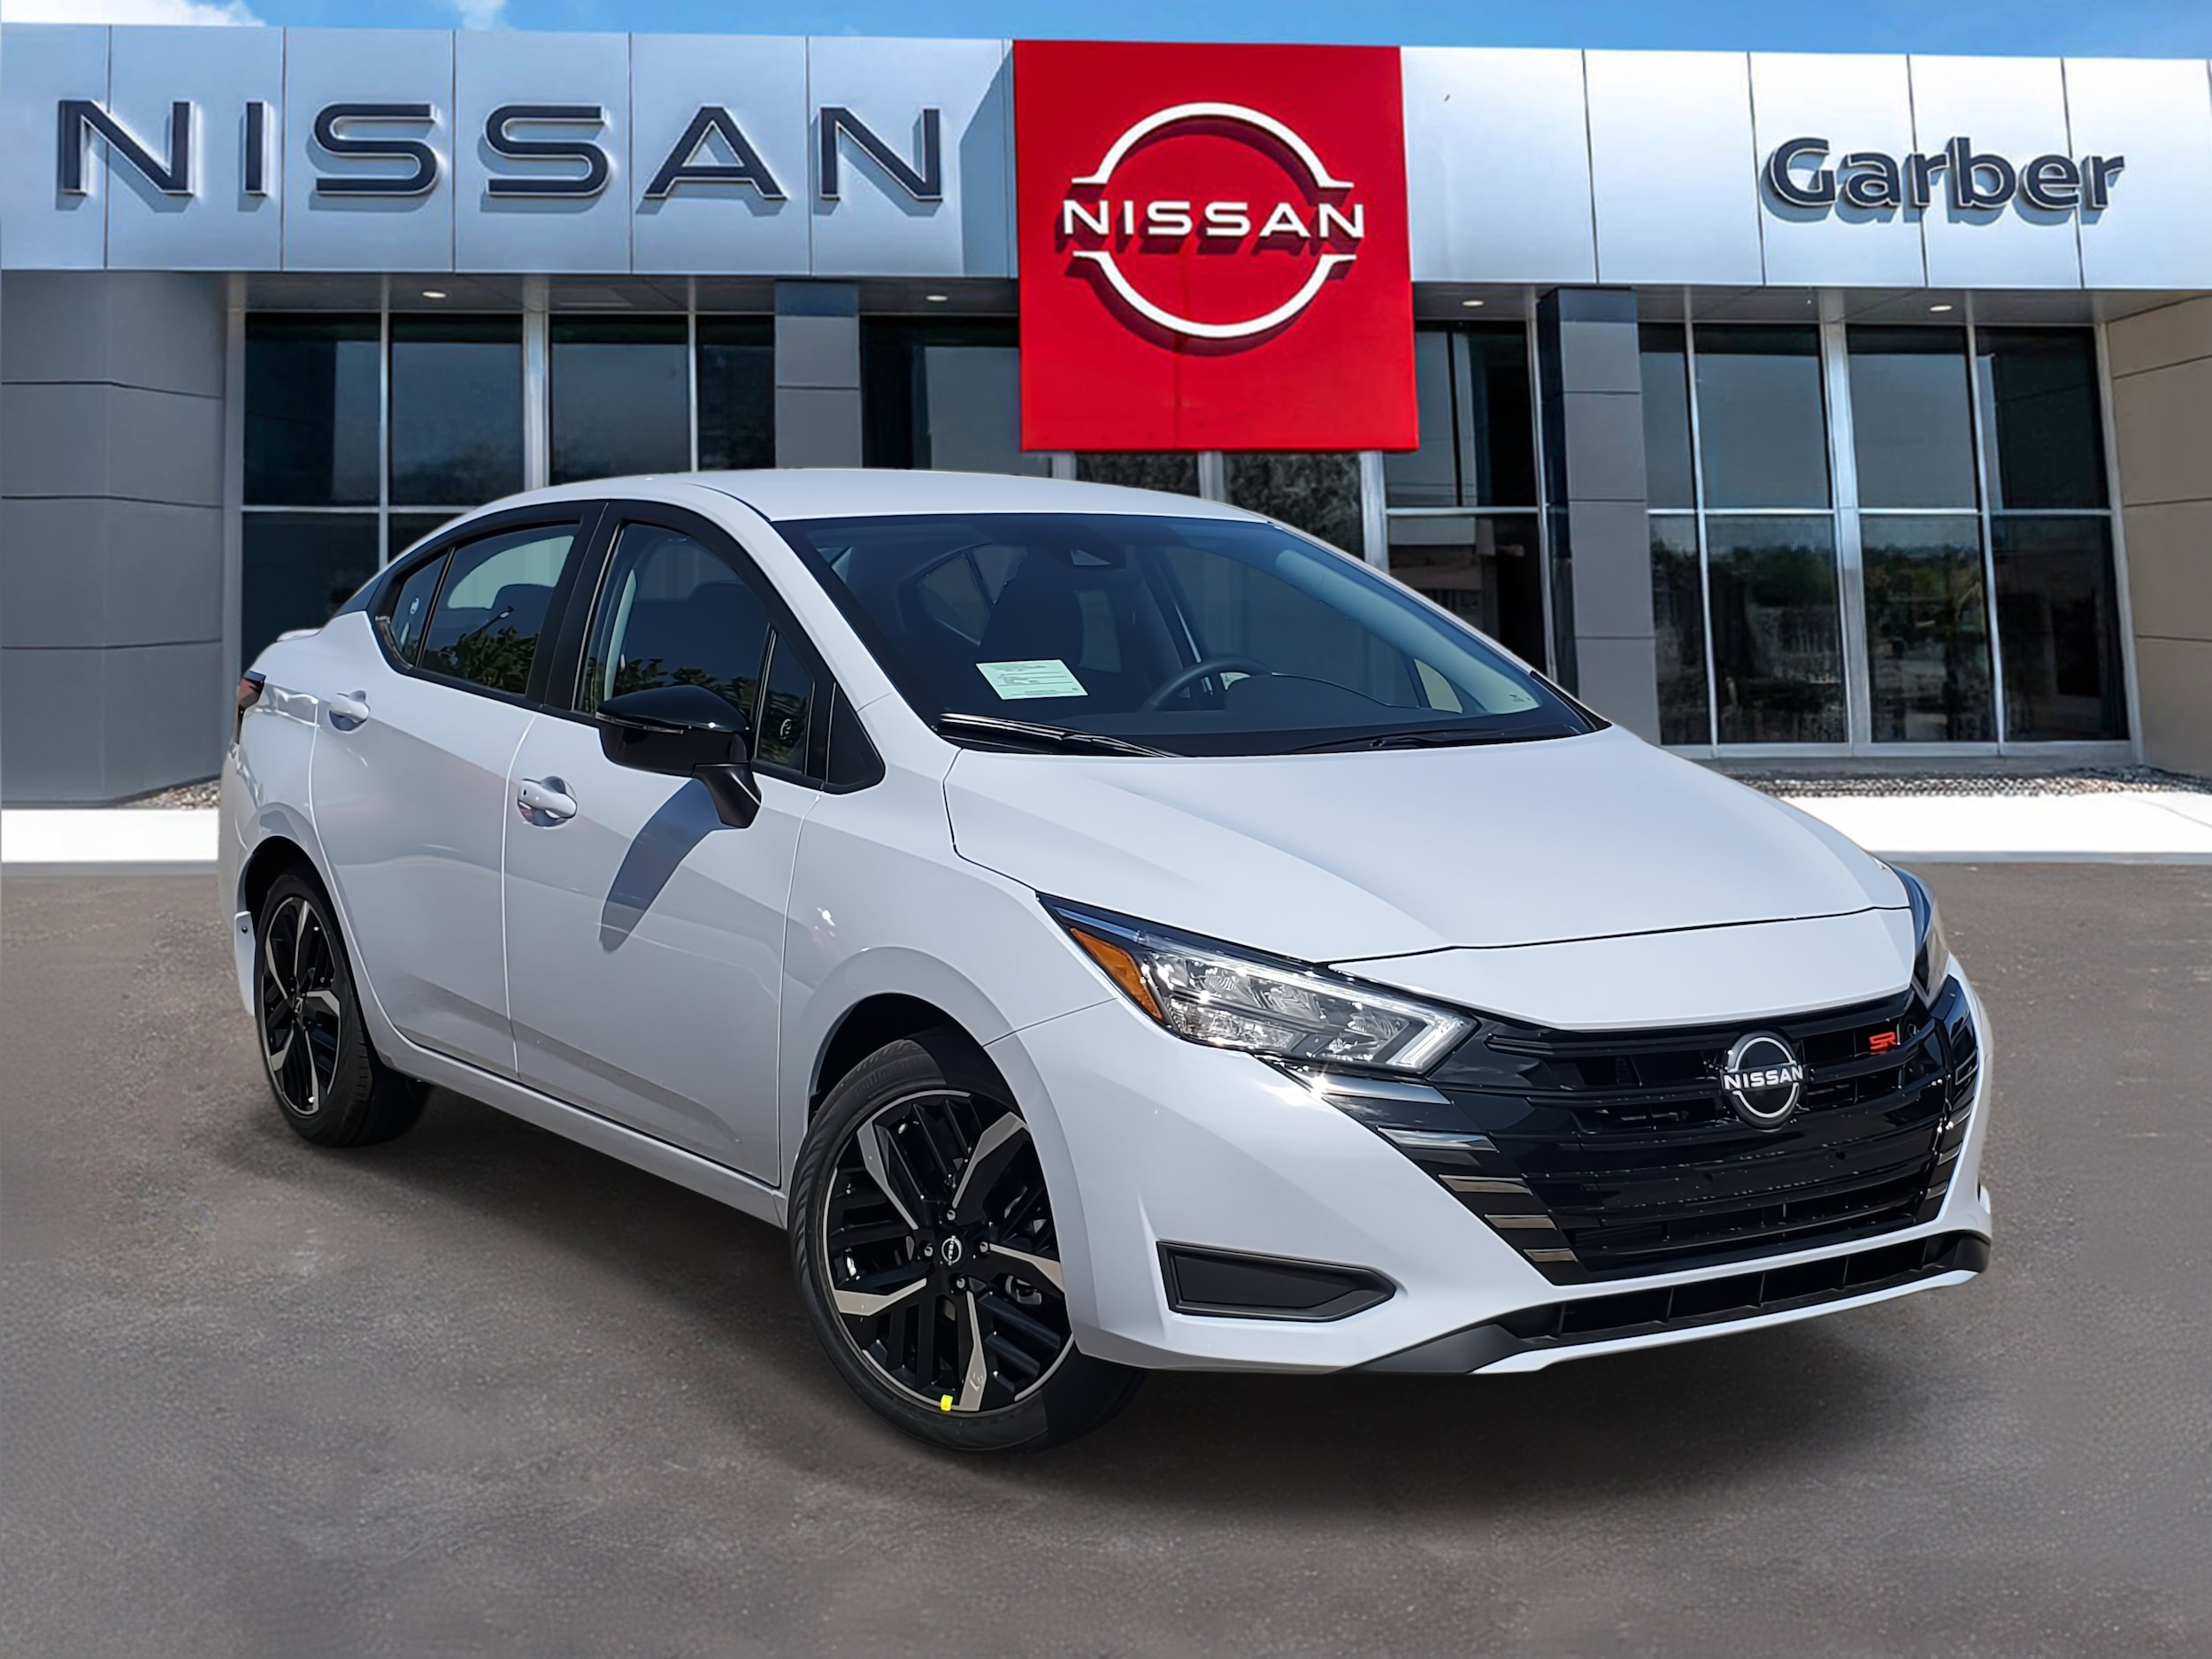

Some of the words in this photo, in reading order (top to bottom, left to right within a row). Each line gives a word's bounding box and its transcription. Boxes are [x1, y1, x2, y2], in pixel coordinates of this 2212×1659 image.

[57, 99, 943, 202] NISSAN
[1767, 135, 2125, 209] Garber
[1063, 199, 1365, 239] NISSAN
[1869, 1031, 1898, 1050] SR
[1723, 1064, 1804, 1090] NISSAN
